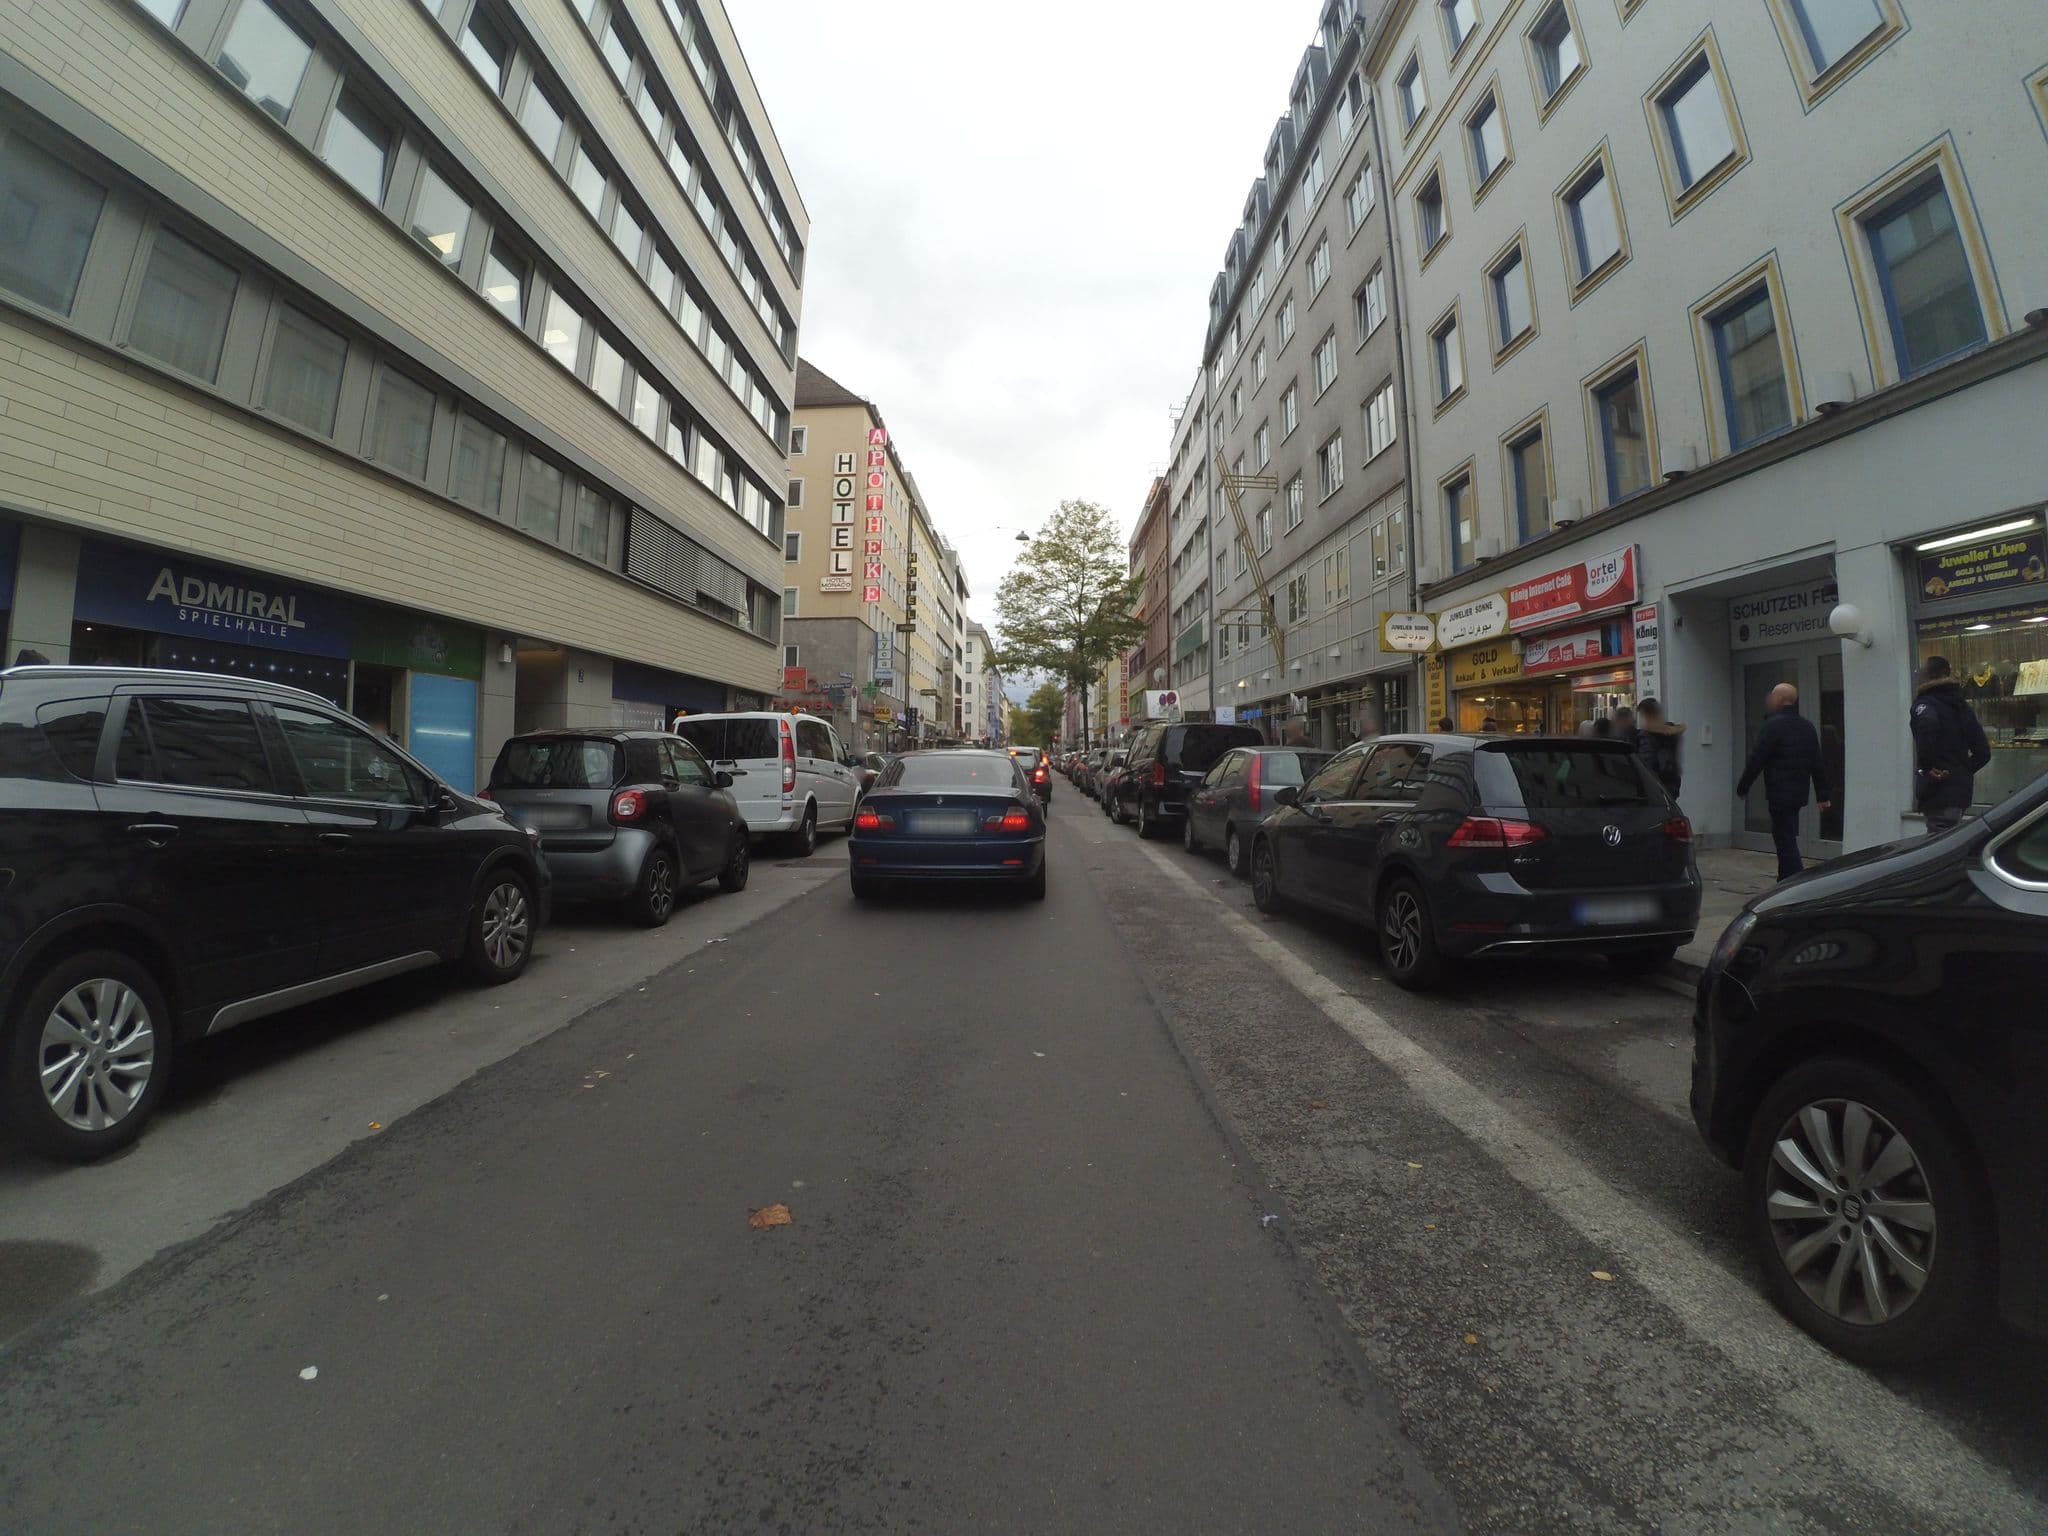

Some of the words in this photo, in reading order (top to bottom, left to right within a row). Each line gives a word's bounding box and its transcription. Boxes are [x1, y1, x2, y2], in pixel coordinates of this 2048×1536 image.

[835, 454, 852, 572] HOTEL
[865, 429, 885, 601] APOTHEKE
[1590, 558, 1617, 579] ortel
[1939, 549, 1990, 568] Juwelier
[908, 553, 917, 619] HOTEL
[1528, 580, 1556, 597] Internet
[1555, 572, 1573, 588] Café
[146, 568, 305, 628] ADMIRAL
[1448, 607, 1473, 622] JUWELIER
[1475, 600, 1493, 615] SONNE
[178, 608, 288, 637] SPIELHALLE
[1636, 625, 1658, 640] König
[1427, 661, 1443, 672] GOLD
[1472, 649, 1498, 666] GOLD
[1455, 671, 1476, 682] Ankauf
[1480, 669, 1487, 679] &
[1491, 663, 1519, 677] Verkauf
